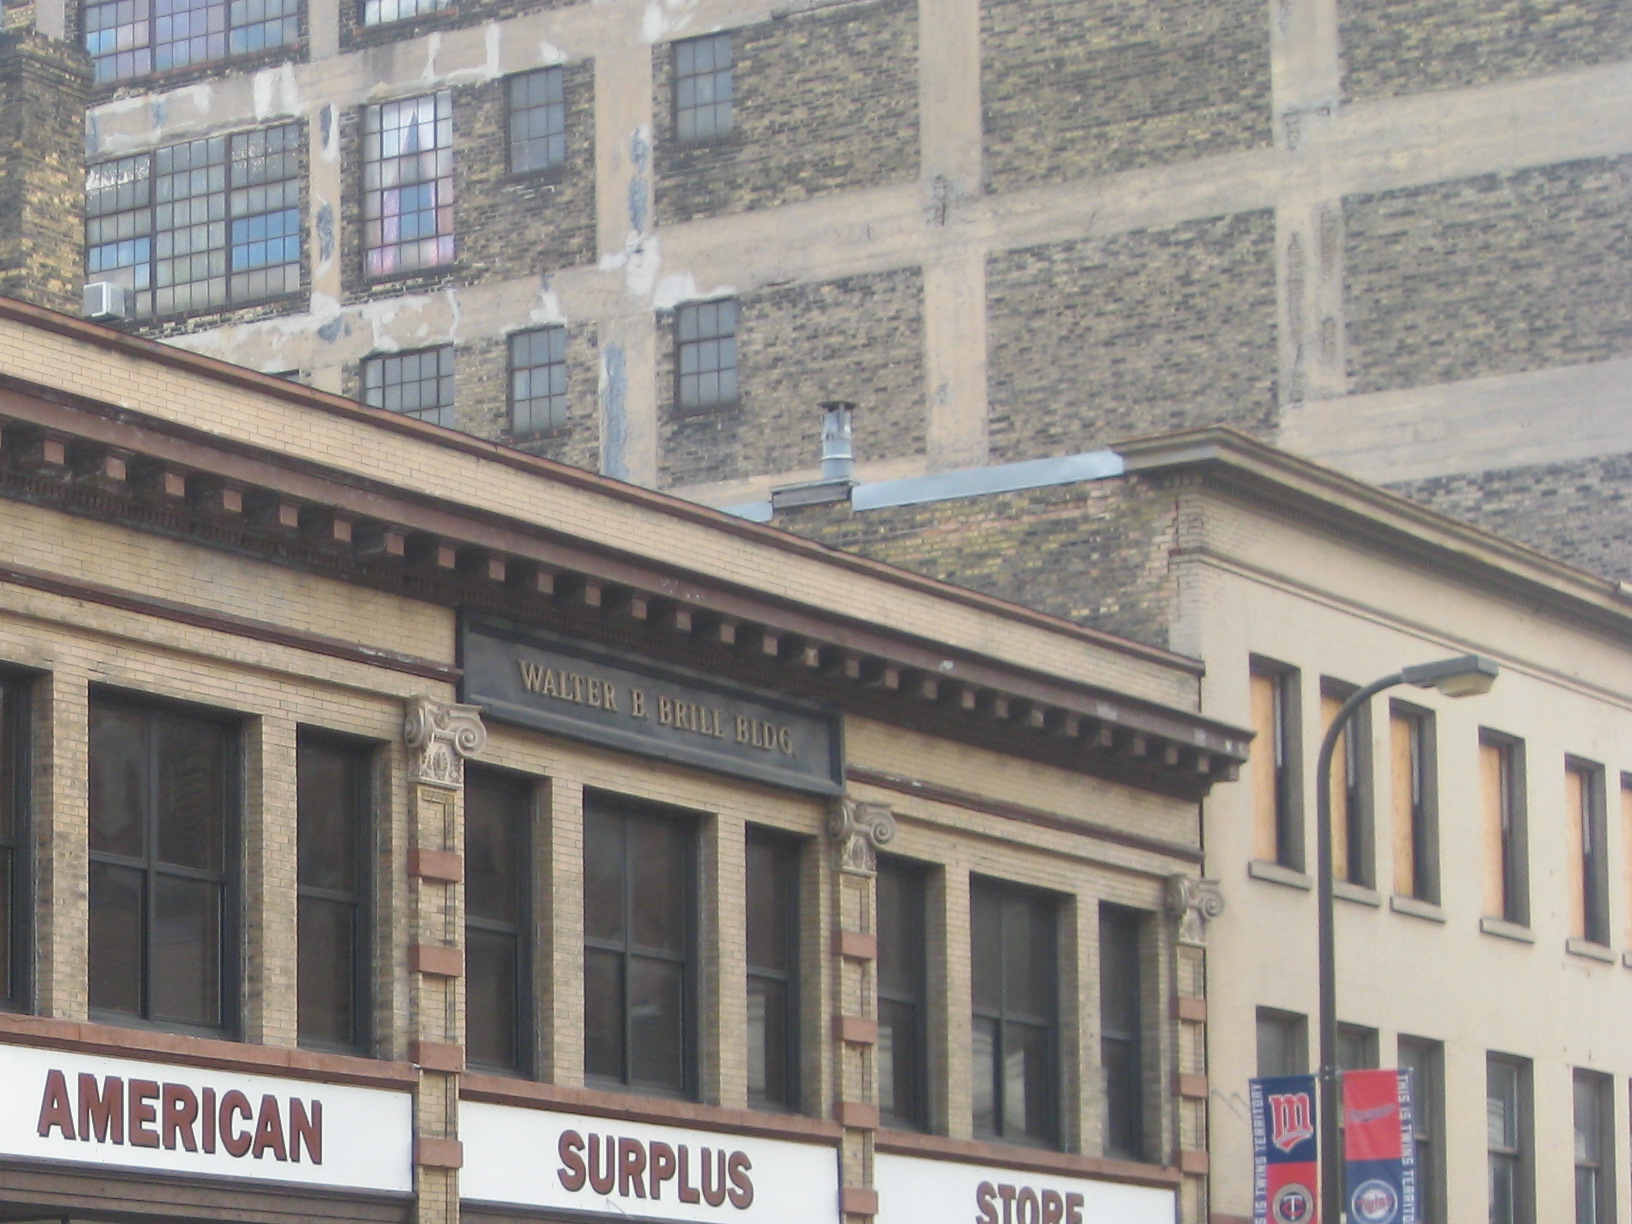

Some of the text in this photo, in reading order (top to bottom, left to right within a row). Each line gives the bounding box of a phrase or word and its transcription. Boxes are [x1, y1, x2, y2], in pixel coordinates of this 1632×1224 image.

[519, 660, 618, 712] WALTER
[631, 688, 649, 719] B.
[657, 695, 724, 738] BRILL
[1398, 1074, 1411, 1103] THIS
[36, 1069, 323, 1166] AMERICAN
[1250, 1083, 1266, 1151] TERRITORY
[1399, 1108, 1411, 1122] IS
[1400, 1125, 1414, 1166] TWINS
[556, 1129, 755, 1211] SURPLUS
[1254, 1157, 1267, 1196] TWINS
[1254, 1201, 1267, 1213] IS
